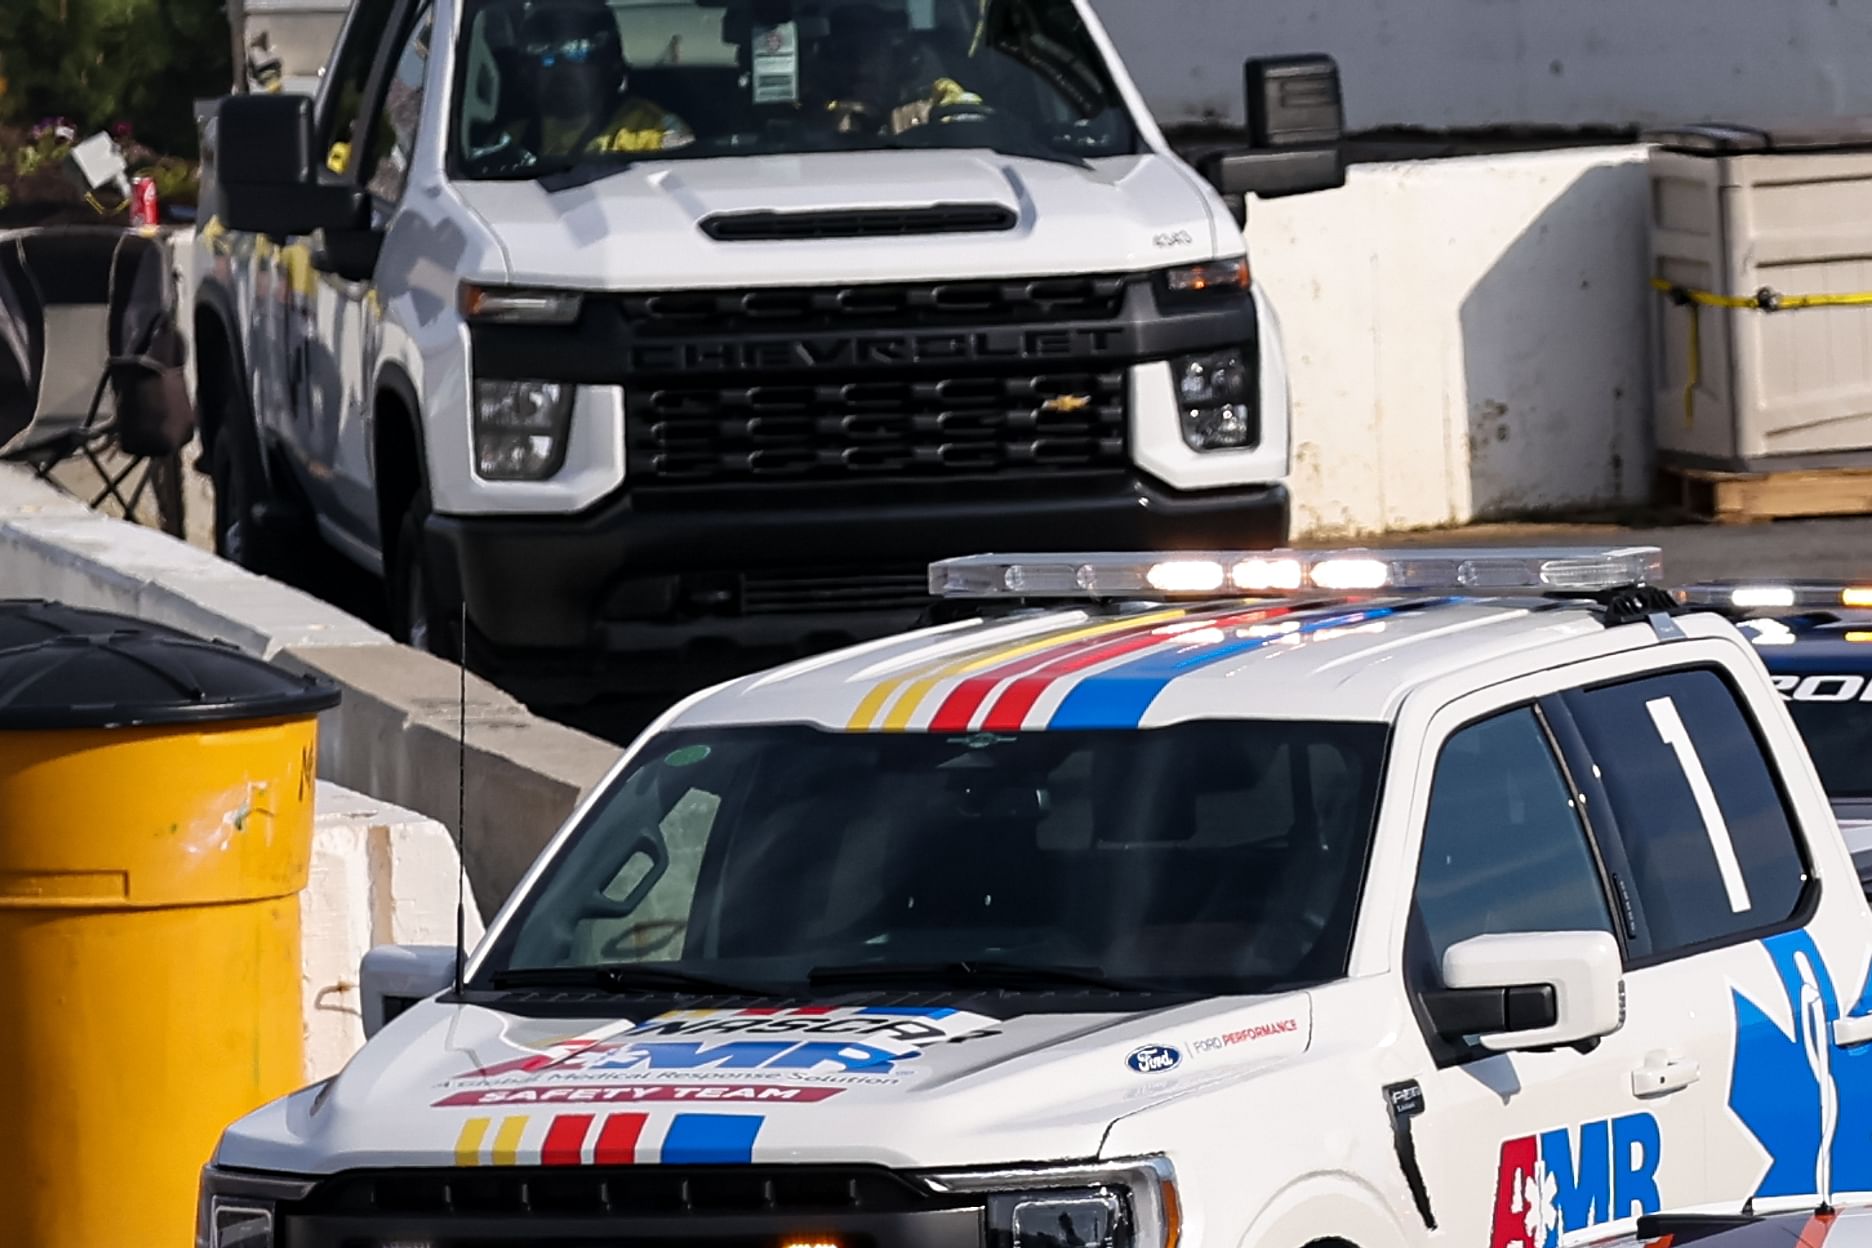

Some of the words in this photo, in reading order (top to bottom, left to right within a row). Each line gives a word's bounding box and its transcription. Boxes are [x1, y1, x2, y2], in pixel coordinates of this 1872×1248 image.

[628, 325, 1124, 372] CHEVROLET
[1646, 697, 1751, 913] 1
[1193, 1036, 1223, 1054] FORD
[1222, 1019, 1298, 1047] PERFORMANCE
[1137, 1048, 1174, 1072] Ford
[547, 1070, 650, 1082] Medical
[656, 1070, 781, 1080] Response
[785, 1071, 901, 1087] Solution
[478, 1086, 662, 1102] SAFETY
[672, 1086, 800, 1100] TEAM
